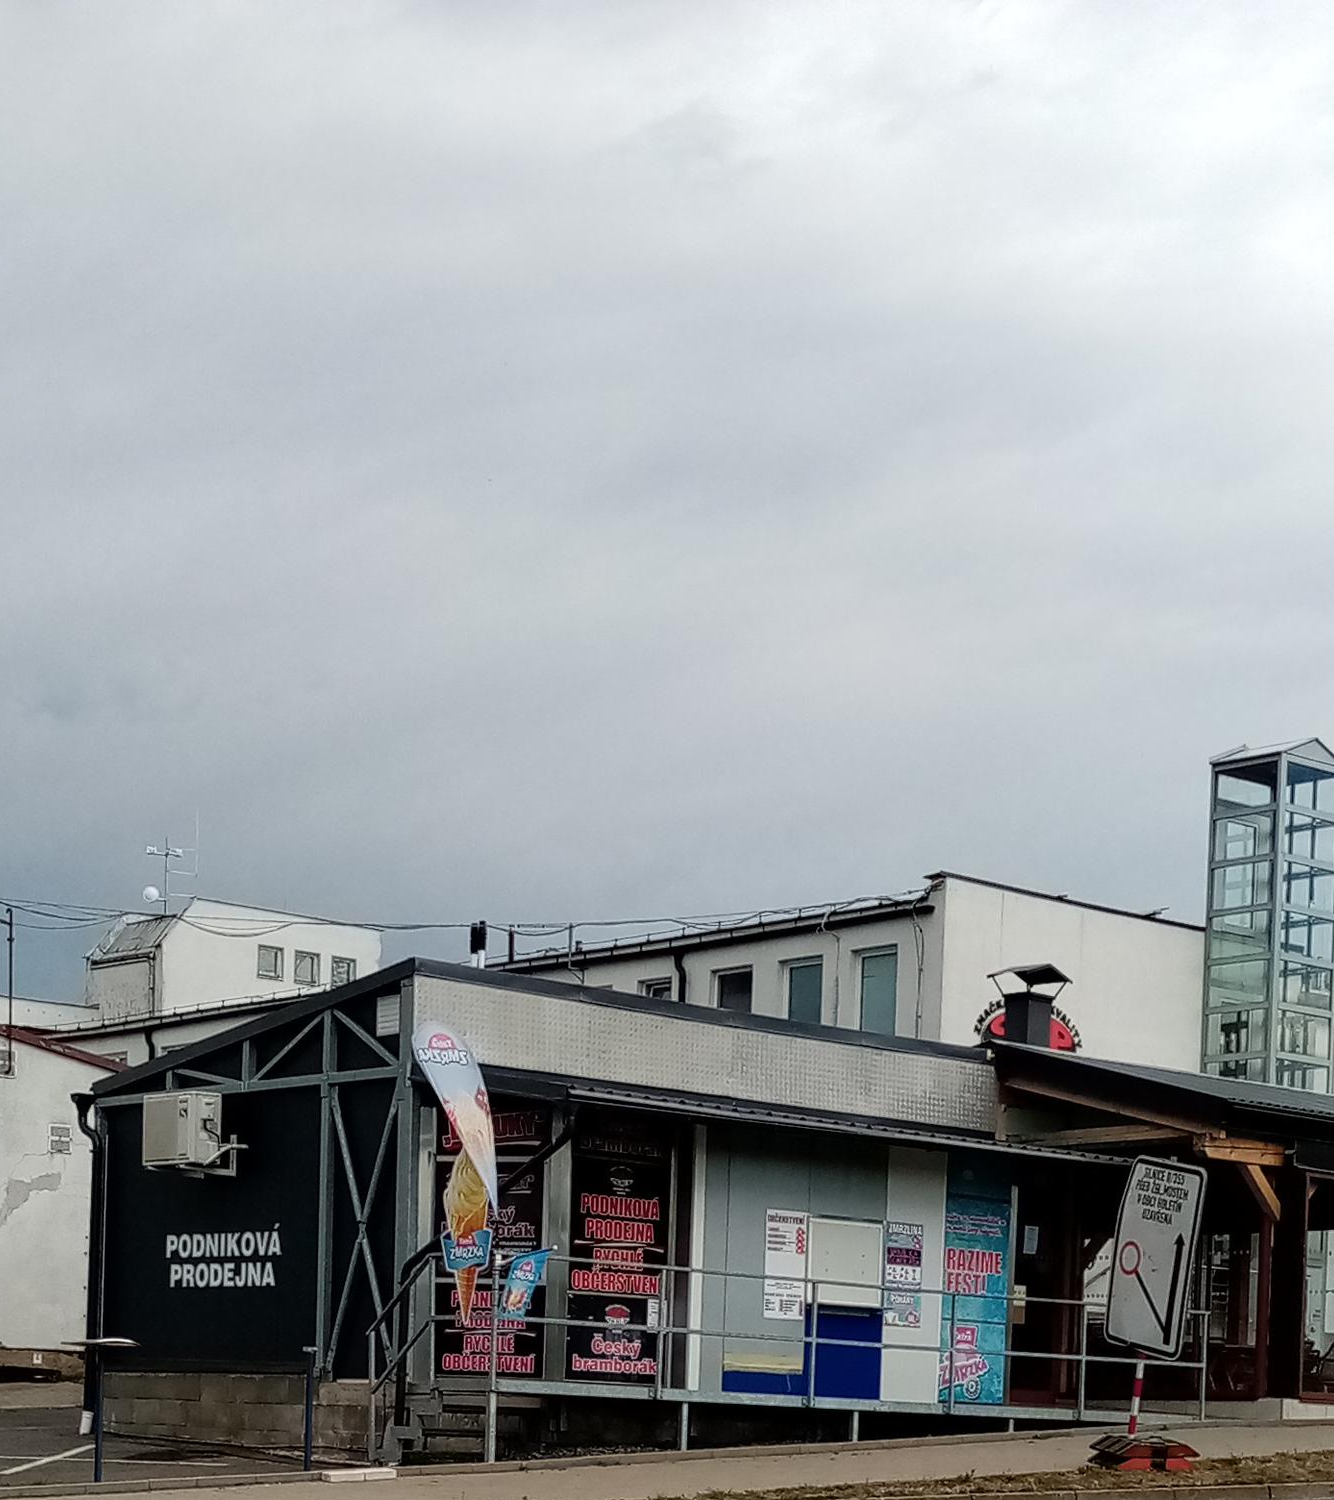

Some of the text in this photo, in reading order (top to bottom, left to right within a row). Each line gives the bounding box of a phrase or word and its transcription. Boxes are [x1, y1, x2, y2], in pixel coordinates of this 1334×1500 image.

[973, 999, 1005, 1035] ZNAČK
[580, 1193, 660, 1220] PODNIKOVÁ
[165, 1222, 283, 1258] PODNIKOVÁ
[585, 1218, 654, 1243] PRODEJNA
[449, 1246, 484, 1260] ZMRZKA
[169, 1261, 276, 1288] PRODEJNA
[571, 1266, 662, 1296] OBČERSTVEN
[946, 1272, 987, 1296] FEST!
[464, 1334, 515, 1353] RYCLÉ
[591, 1332, 642, 1359] Český
[571, 1354, 658, 1375] bramborák
